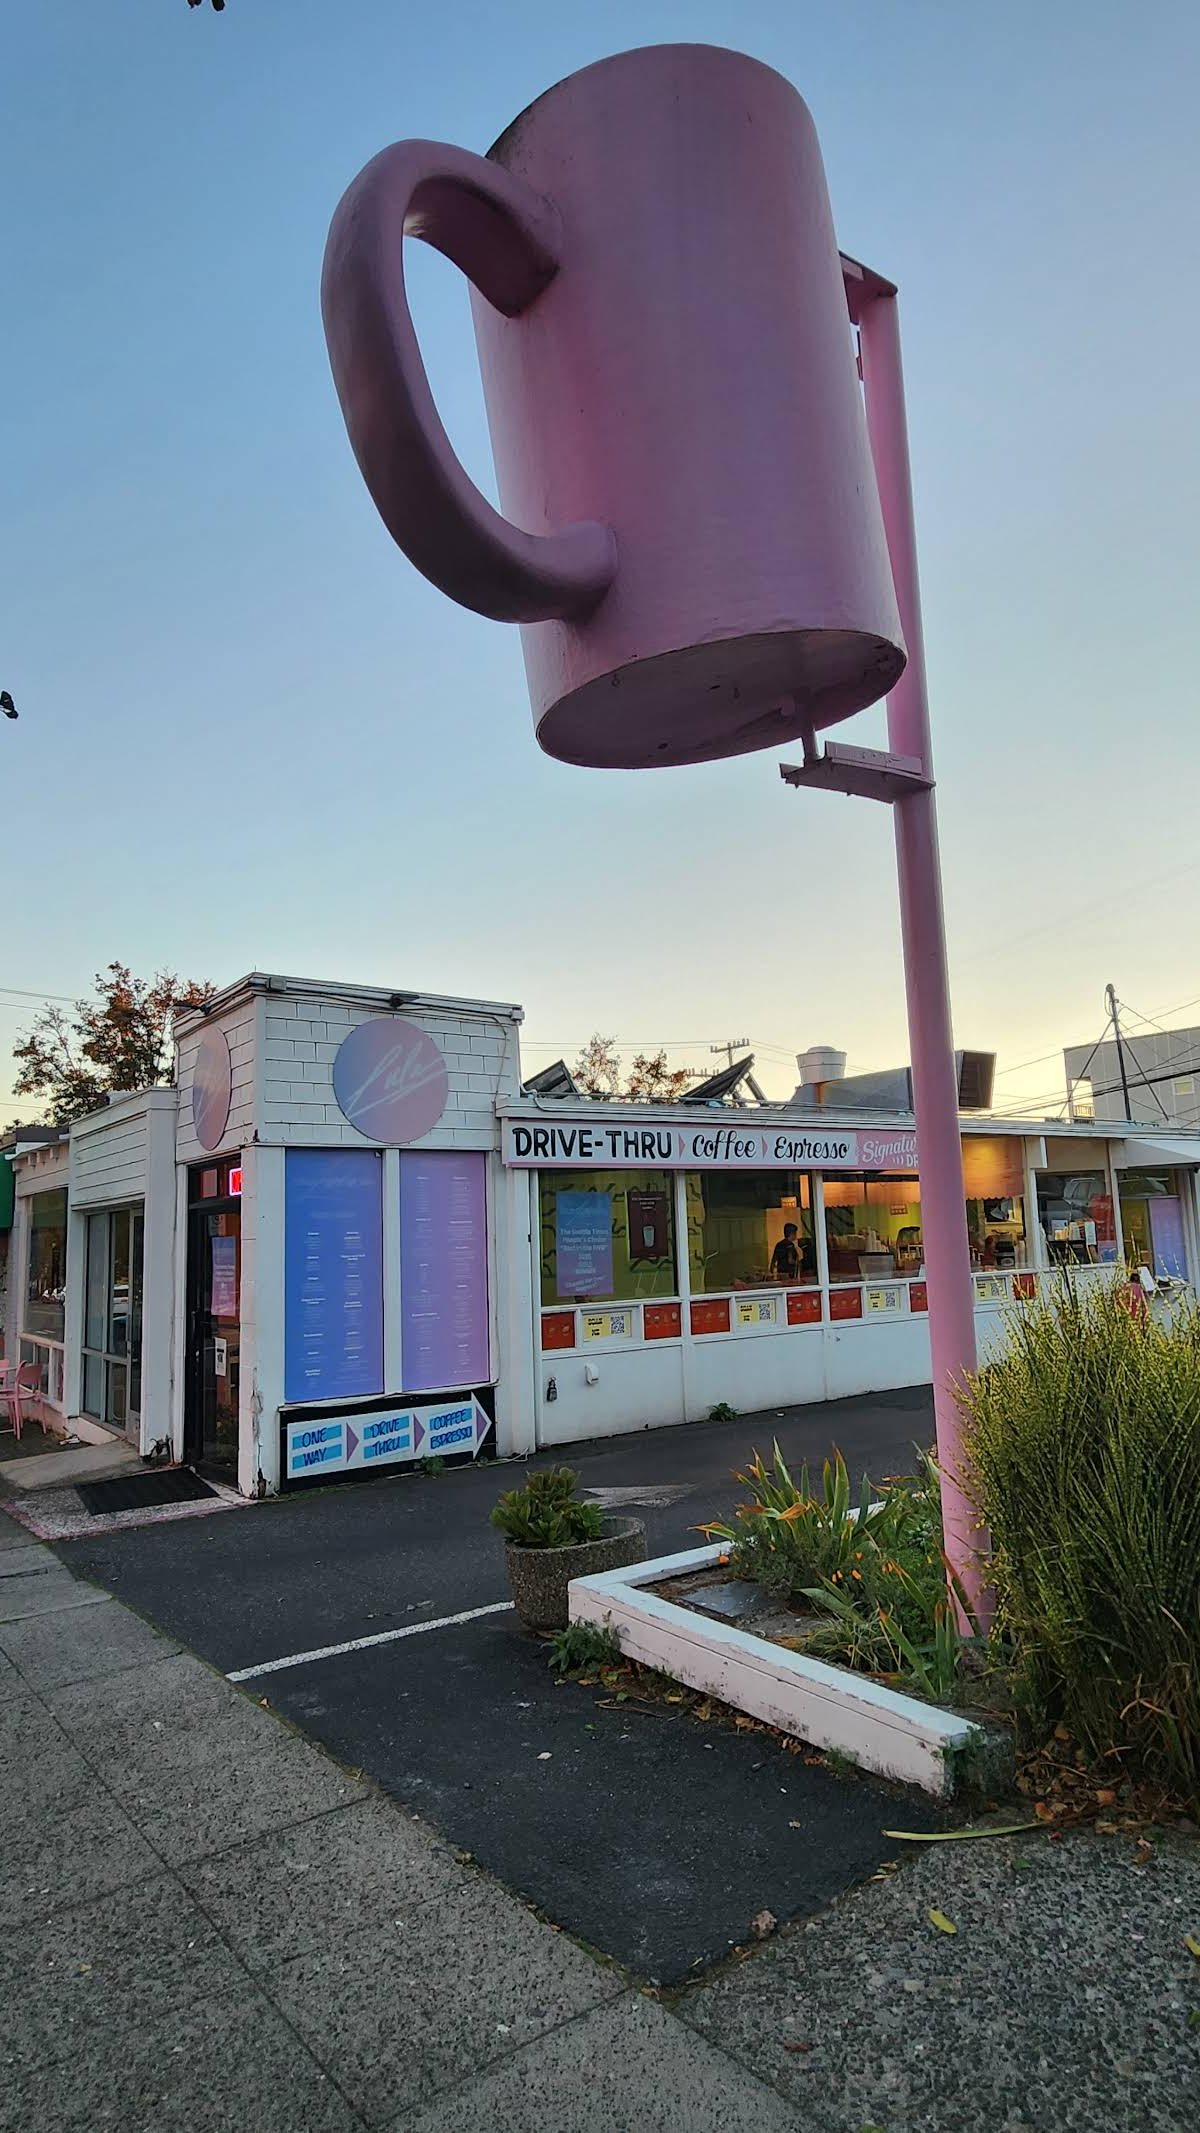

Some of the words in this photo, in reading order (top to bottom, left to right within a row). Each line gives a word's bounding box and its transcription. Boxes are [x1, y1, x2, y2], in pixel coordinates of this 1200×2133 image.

[512, 1127, 672, 1159] DRIVE-THRU
[692, 1130, 755, 1159] Coffee
[774, 1136, 849, 1163] Espresso
[371, 1417, 400, 1438] DRIVE
[433, 1408, 467, 1431] COFFEE
[302, 1427, 328, 1448] ONE
[372, 1436, 400, 1457] THRU
[430, 1426, 473, 1450] ESPRESSO
[303, 1447, 327, 1467] WAY
